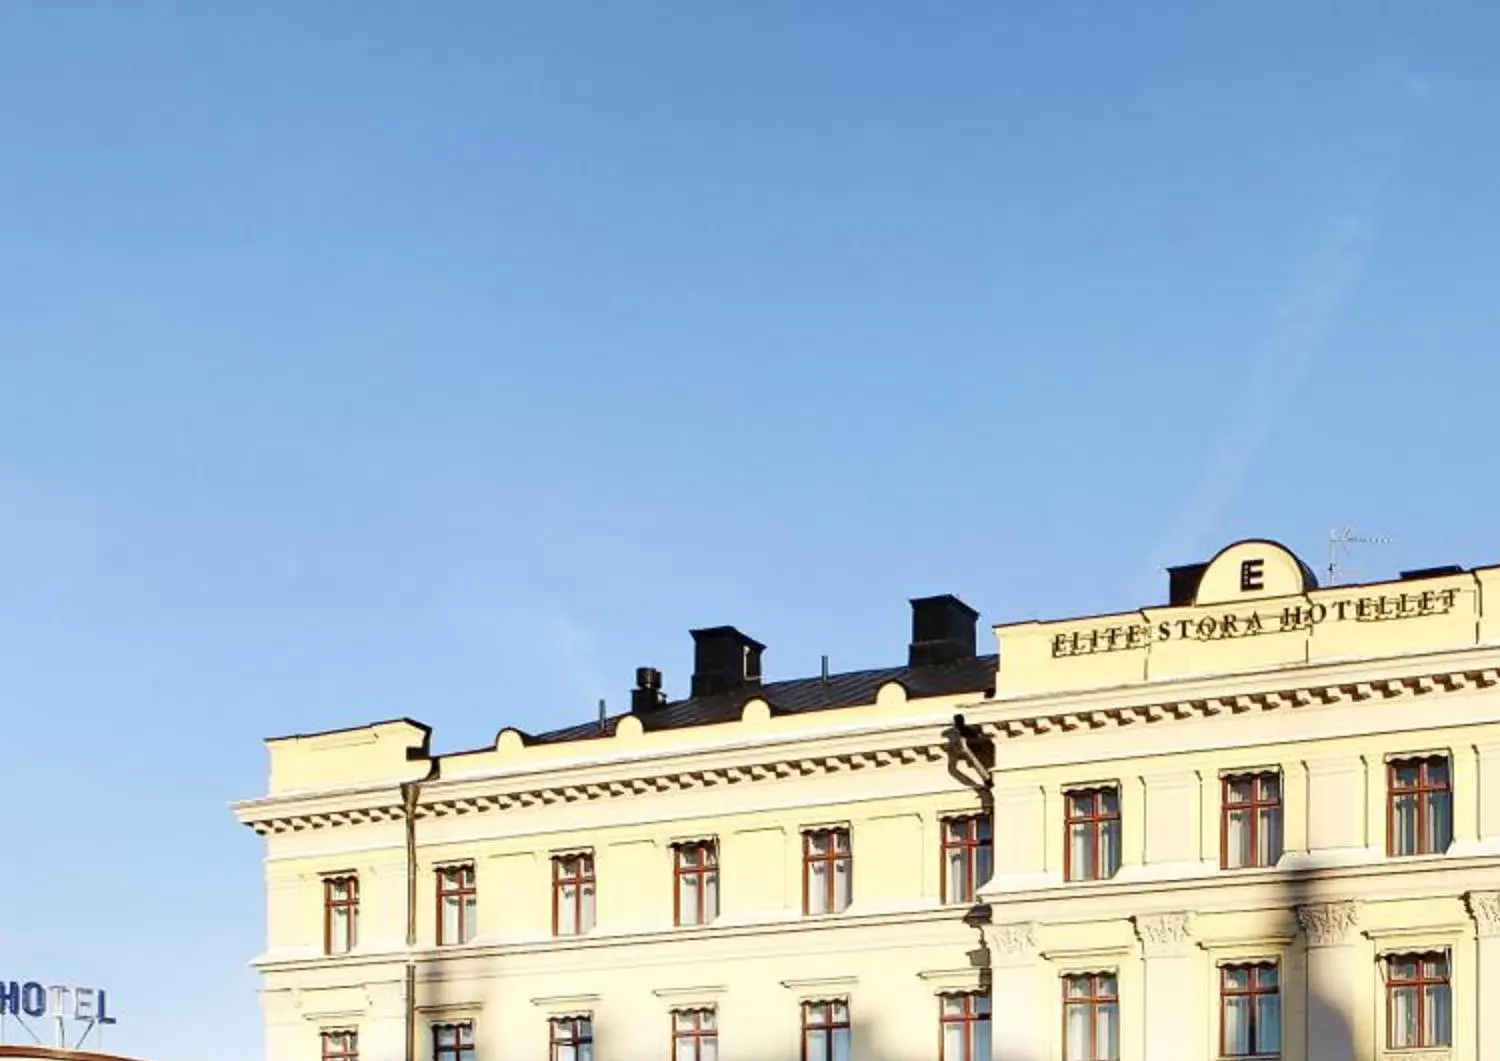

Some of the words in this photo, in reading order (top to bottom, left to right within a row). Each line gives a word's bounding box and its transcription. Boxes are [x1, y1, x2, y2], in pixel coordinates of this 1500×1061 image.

[1241, 558, 1264, 592] E
[1053, 624, 1142, 654] ELITE
[1159, 611, 1264, 641] STORA
[1282, 587, 1461, 630] HOTELLET
[0, 980, 117, 1025] HOTEL
